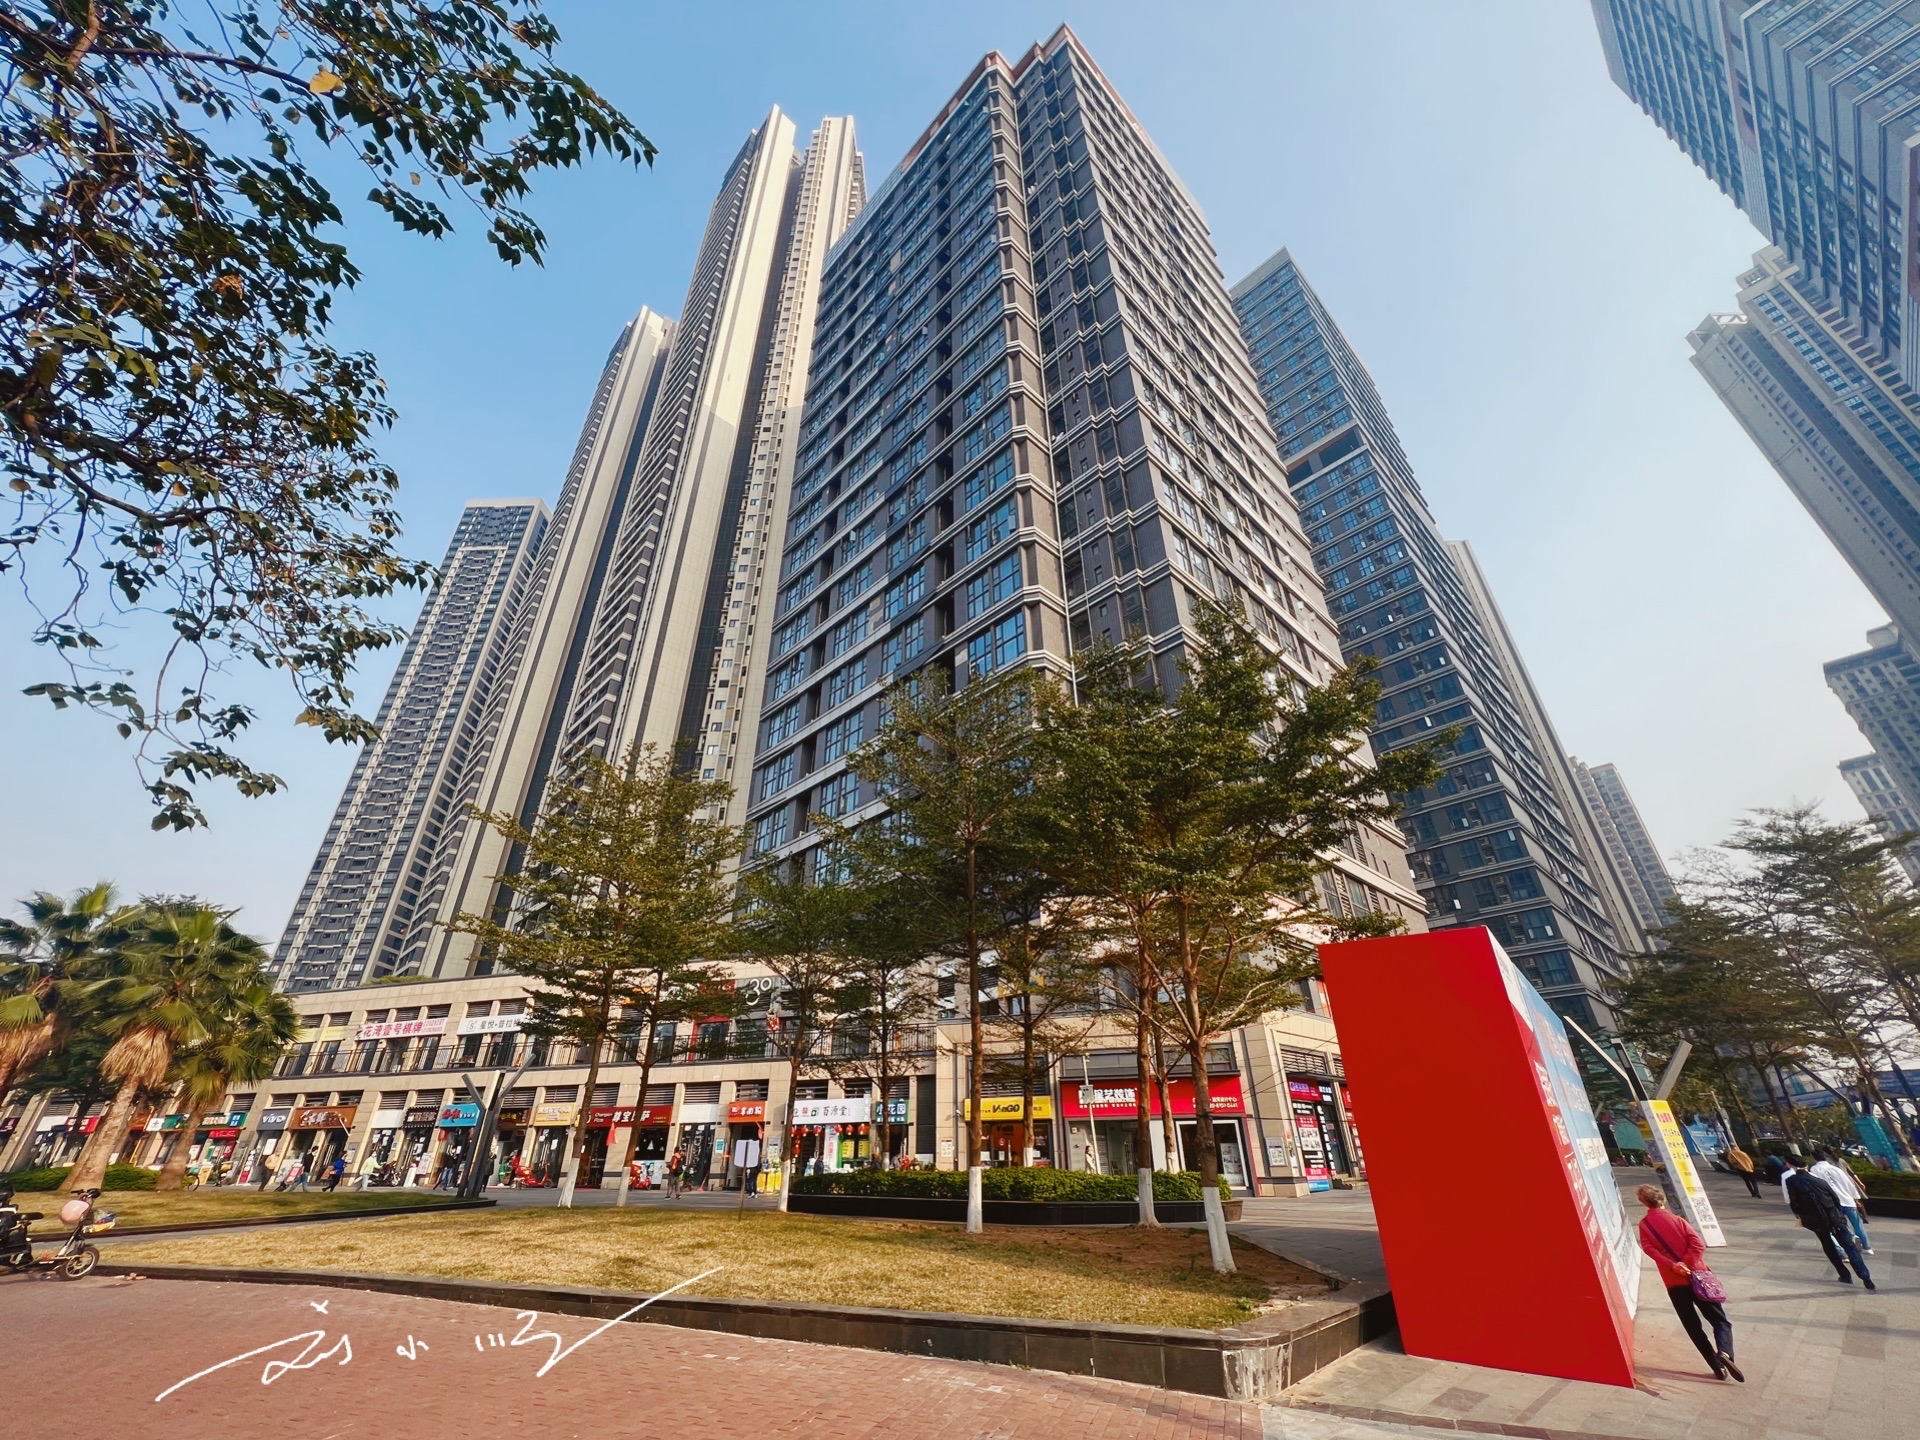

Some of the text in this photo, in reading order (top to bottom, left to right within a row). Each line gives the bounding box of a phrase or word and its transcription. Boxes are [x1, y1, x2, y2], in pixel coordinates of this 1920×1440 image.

[362, 1021, 424, 1039] 花湾壹号棋牌
[262, 1112, 286, 1124] vivo
